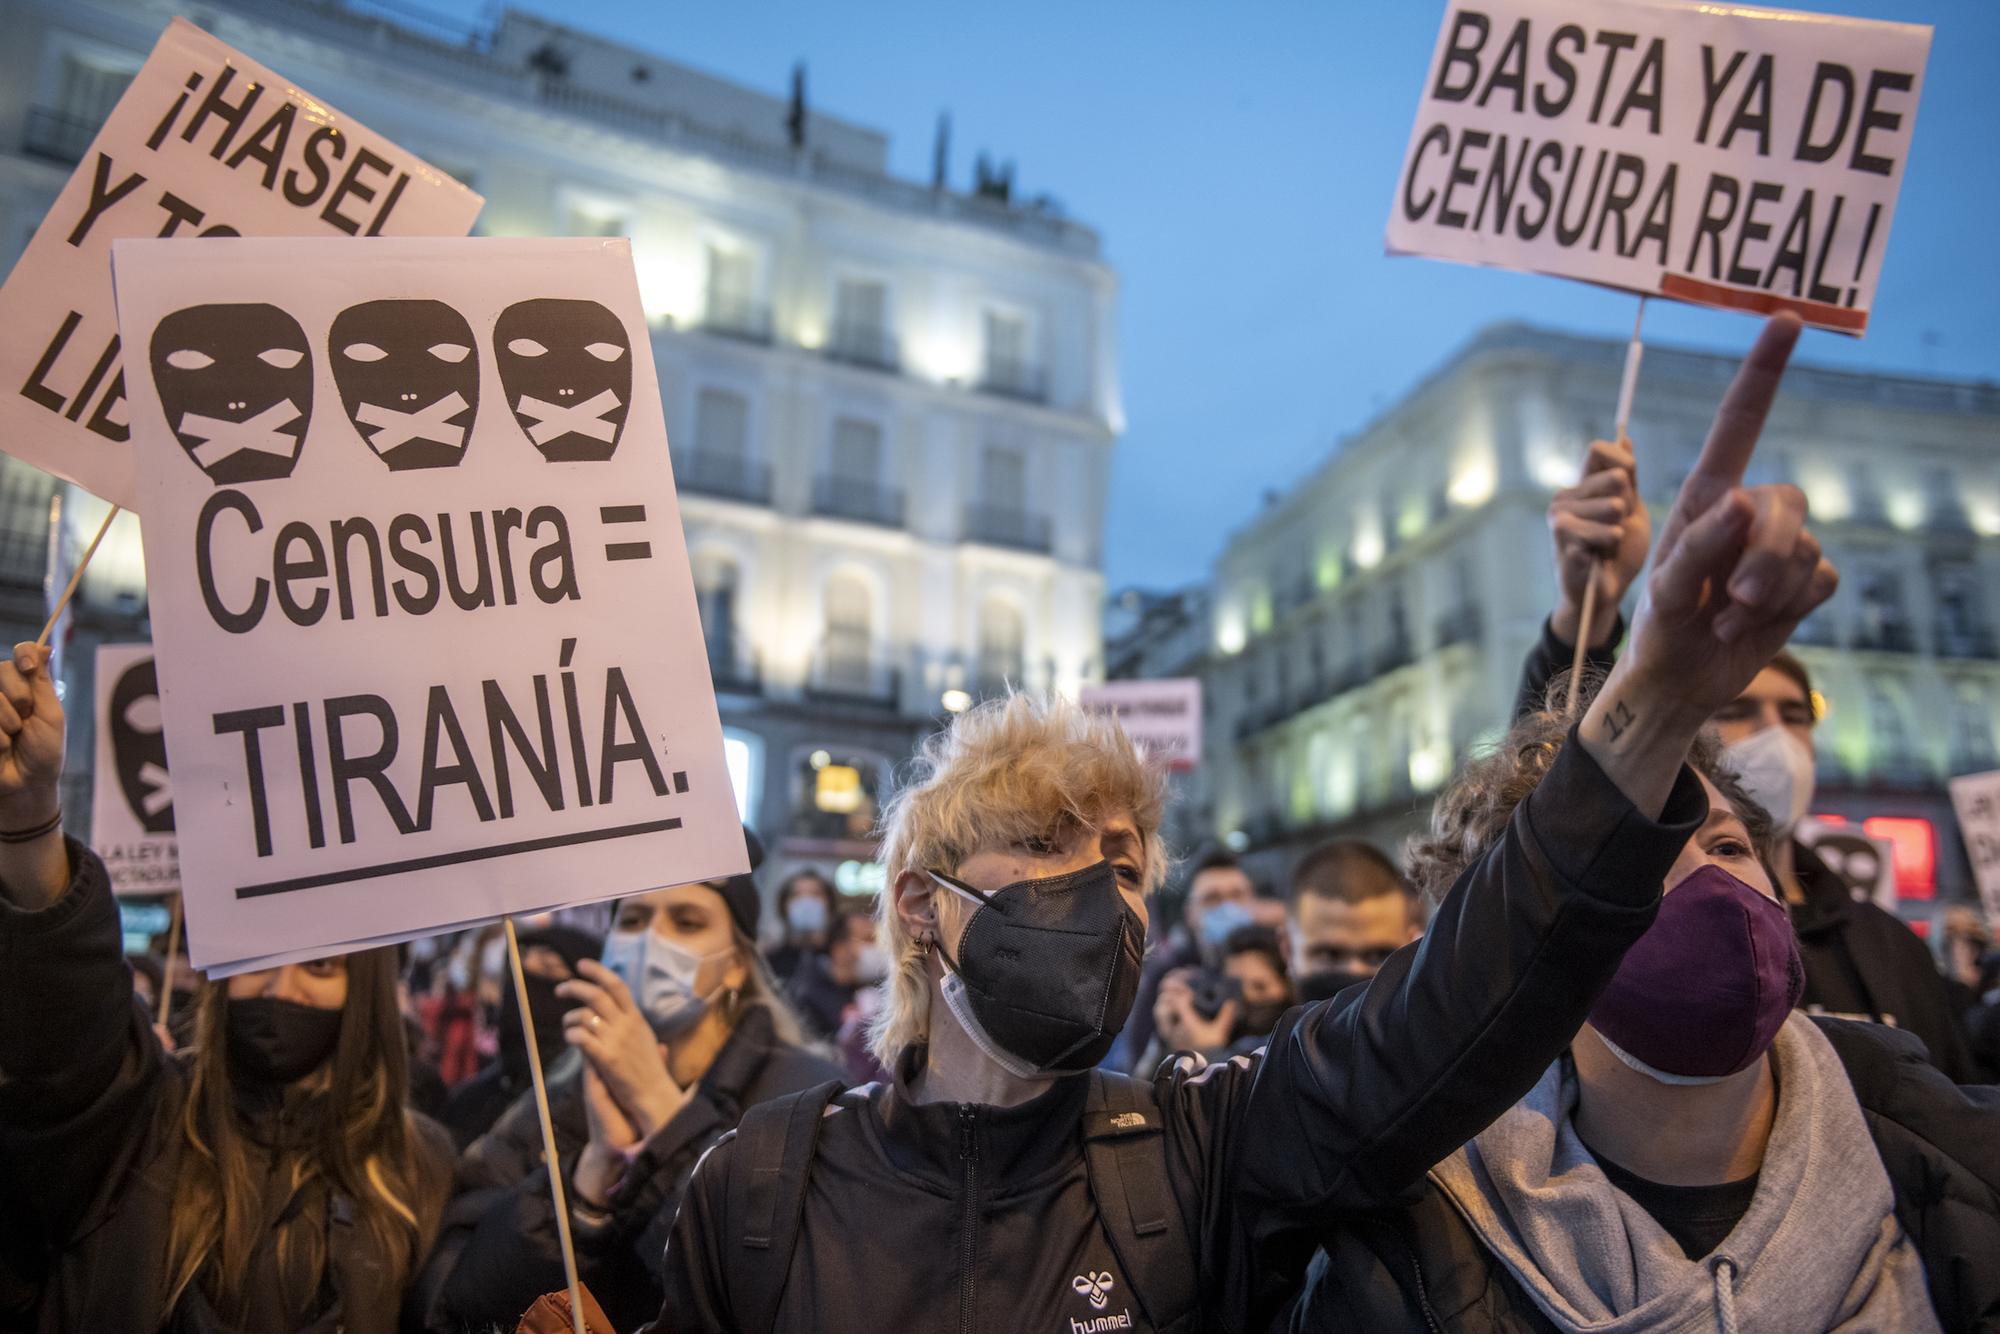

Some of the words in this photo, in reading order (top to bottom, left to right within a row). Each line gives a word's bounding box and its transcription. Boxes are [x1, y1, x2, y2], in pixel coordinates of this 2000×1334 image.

[1433, 11, 1664, 135] BASTA
[1695, 45, 1774, 156] YA
[1793, 62, 1915, 177] DE
[67, 152, 148, 248] Y
[157, 191, 242, 239] T
[1404, 124, 1677, 266] CENSURA
[1686, 174, 1882, 309] REAL!
[196, 489, 581, 634] Censura
[212, 637, 690, 857] TIRANÍA.
[1602, 700, 1636, 743] 11
[1070, 1308, 1132, 1334] hummel
